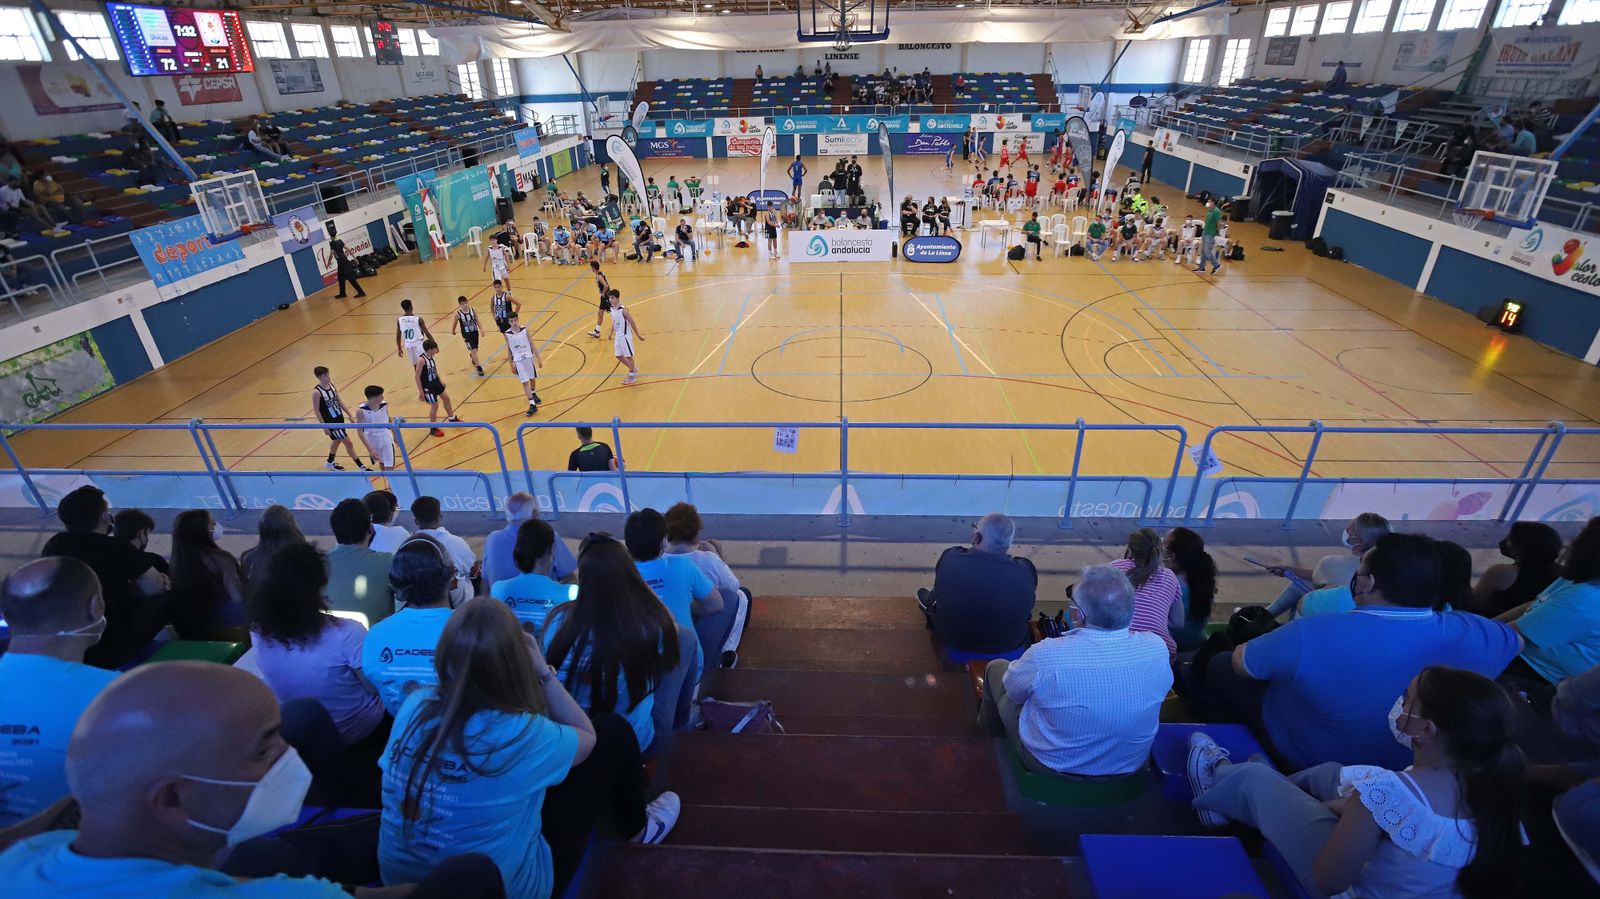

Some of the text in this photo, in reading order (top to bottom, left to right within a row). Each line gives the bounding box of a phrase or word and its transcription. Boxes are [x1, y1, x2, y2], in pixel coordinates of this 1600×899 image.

[898, 42, 952, 51] BALONCESTO
[160, 58, 177, 71] 72
[216, 58, 229, 69] 21
[203, 76, 236, 90] CEPSA
[832, 237, 873, 247] baloncesto
[916, 244, 957, 253] Ayuntamiento
[1500, 311, 1517, 326] 14
[404, 328, 415, 339] 10
[395, 648, 436, 657] CADEB
